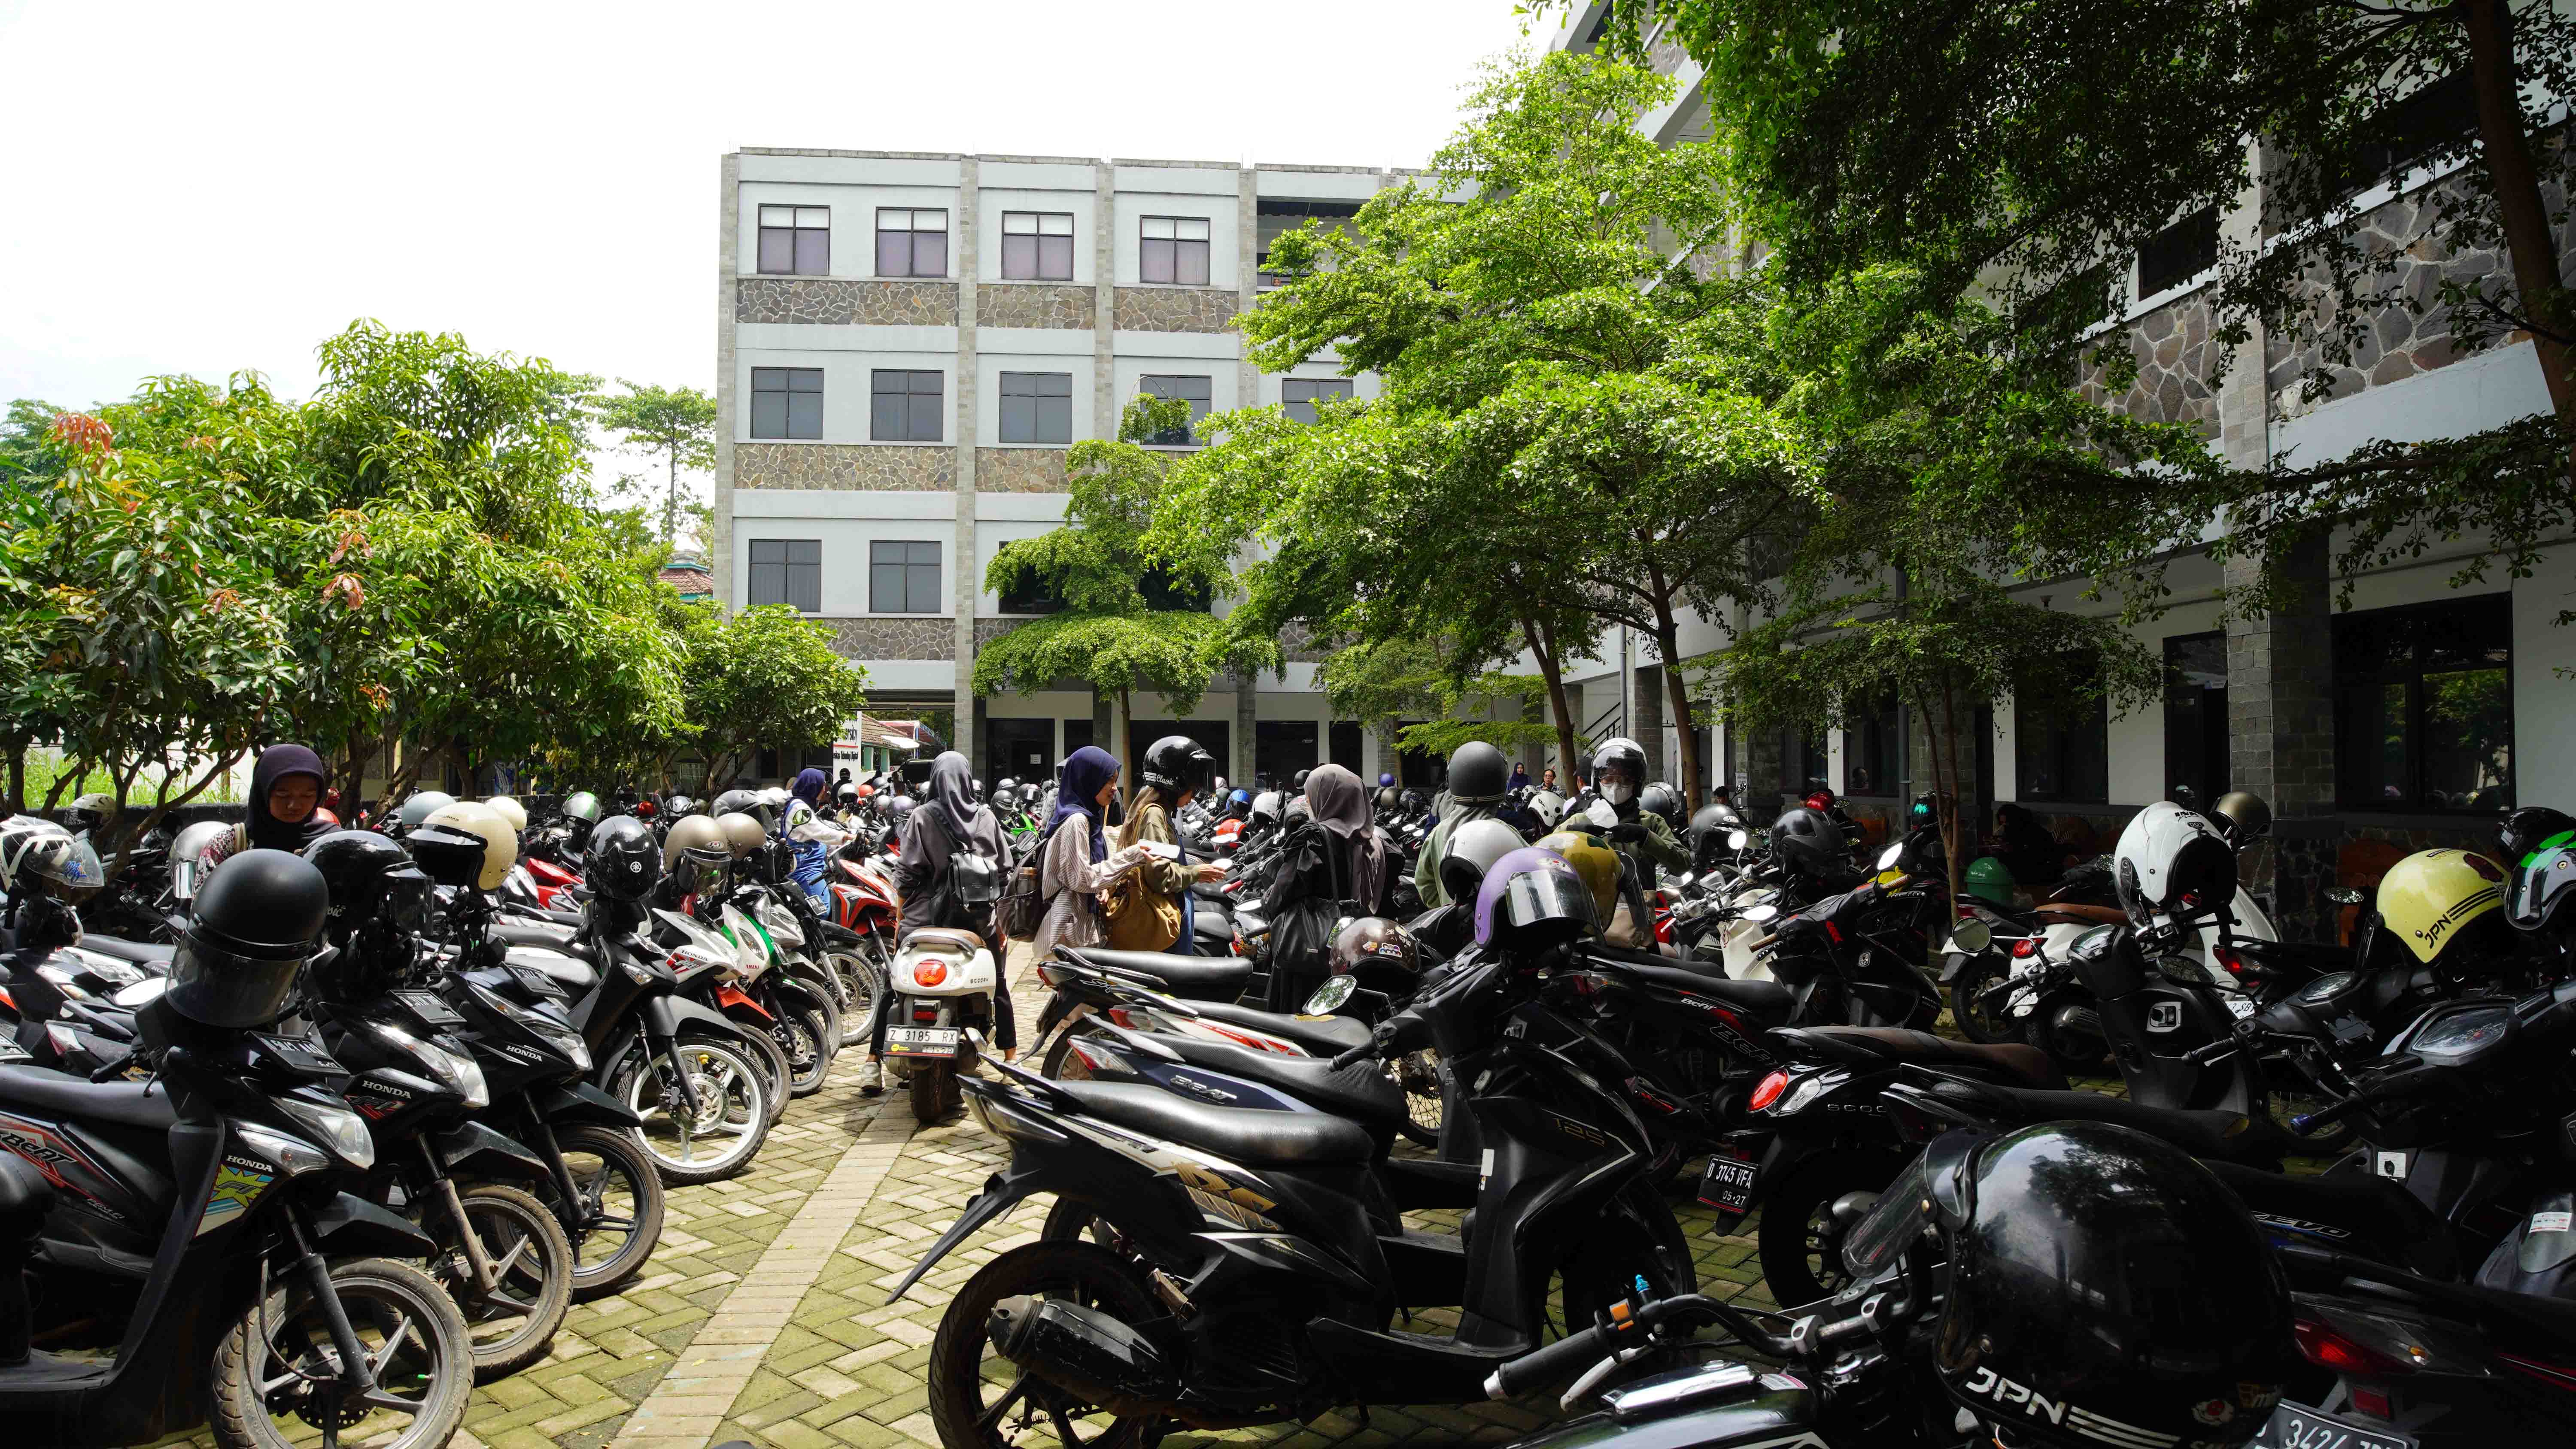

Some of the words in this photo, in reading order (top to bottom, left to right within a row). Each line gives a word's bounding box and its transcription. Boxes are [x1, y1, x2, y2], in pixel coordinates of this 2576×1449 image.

[1156, 774, 1174, 785] Classic
[2424, 914, 2451, 949] JPN
[681, 950, 708, 961] HONDA
[890, 1030, 896, 1040] Z
[905, 1031, 930, 1042] 3185
[941, 1033, 953, 1043] RX
[506, 1045, 542, 1062] HONDA
[362, 1079, 411, 1099] HONDA
[1170, 1074, 1237, 1099] BEAT
[226, 1155, 273, 1173] HONDA
[1707, 1162, 1714, 1179] D
[1716, 1165, 1735, 1183] 3745
[1736, 1170, 1752, 1189] VFA
[1966, 1366, 2066, 1425] JPN
